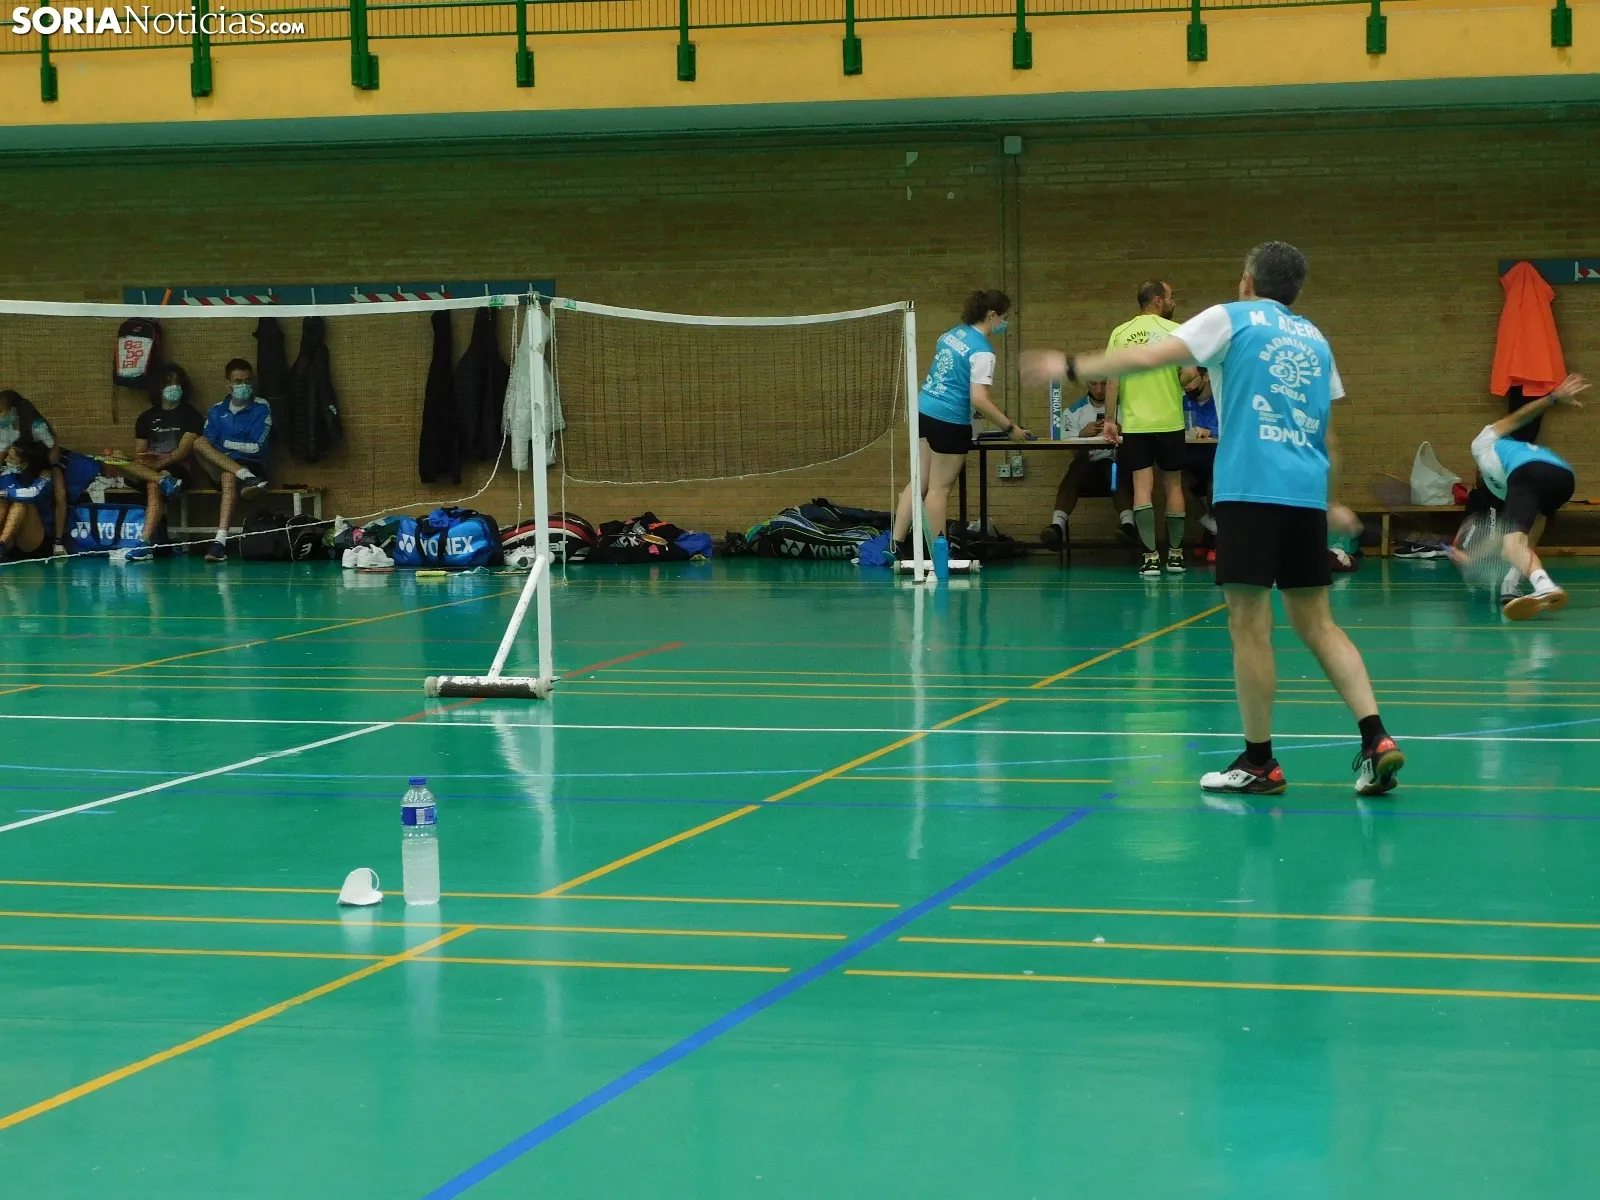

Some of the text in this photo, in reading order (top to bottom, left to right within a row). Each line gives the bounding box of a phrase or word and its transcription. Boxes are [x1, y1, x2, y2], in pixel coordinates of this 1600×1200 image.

[1259, 336, 1322, 377] BADMINTON
[1052, 388, 1061, 413] YONEX
[1270, 383, 1307, 403] SORIA
